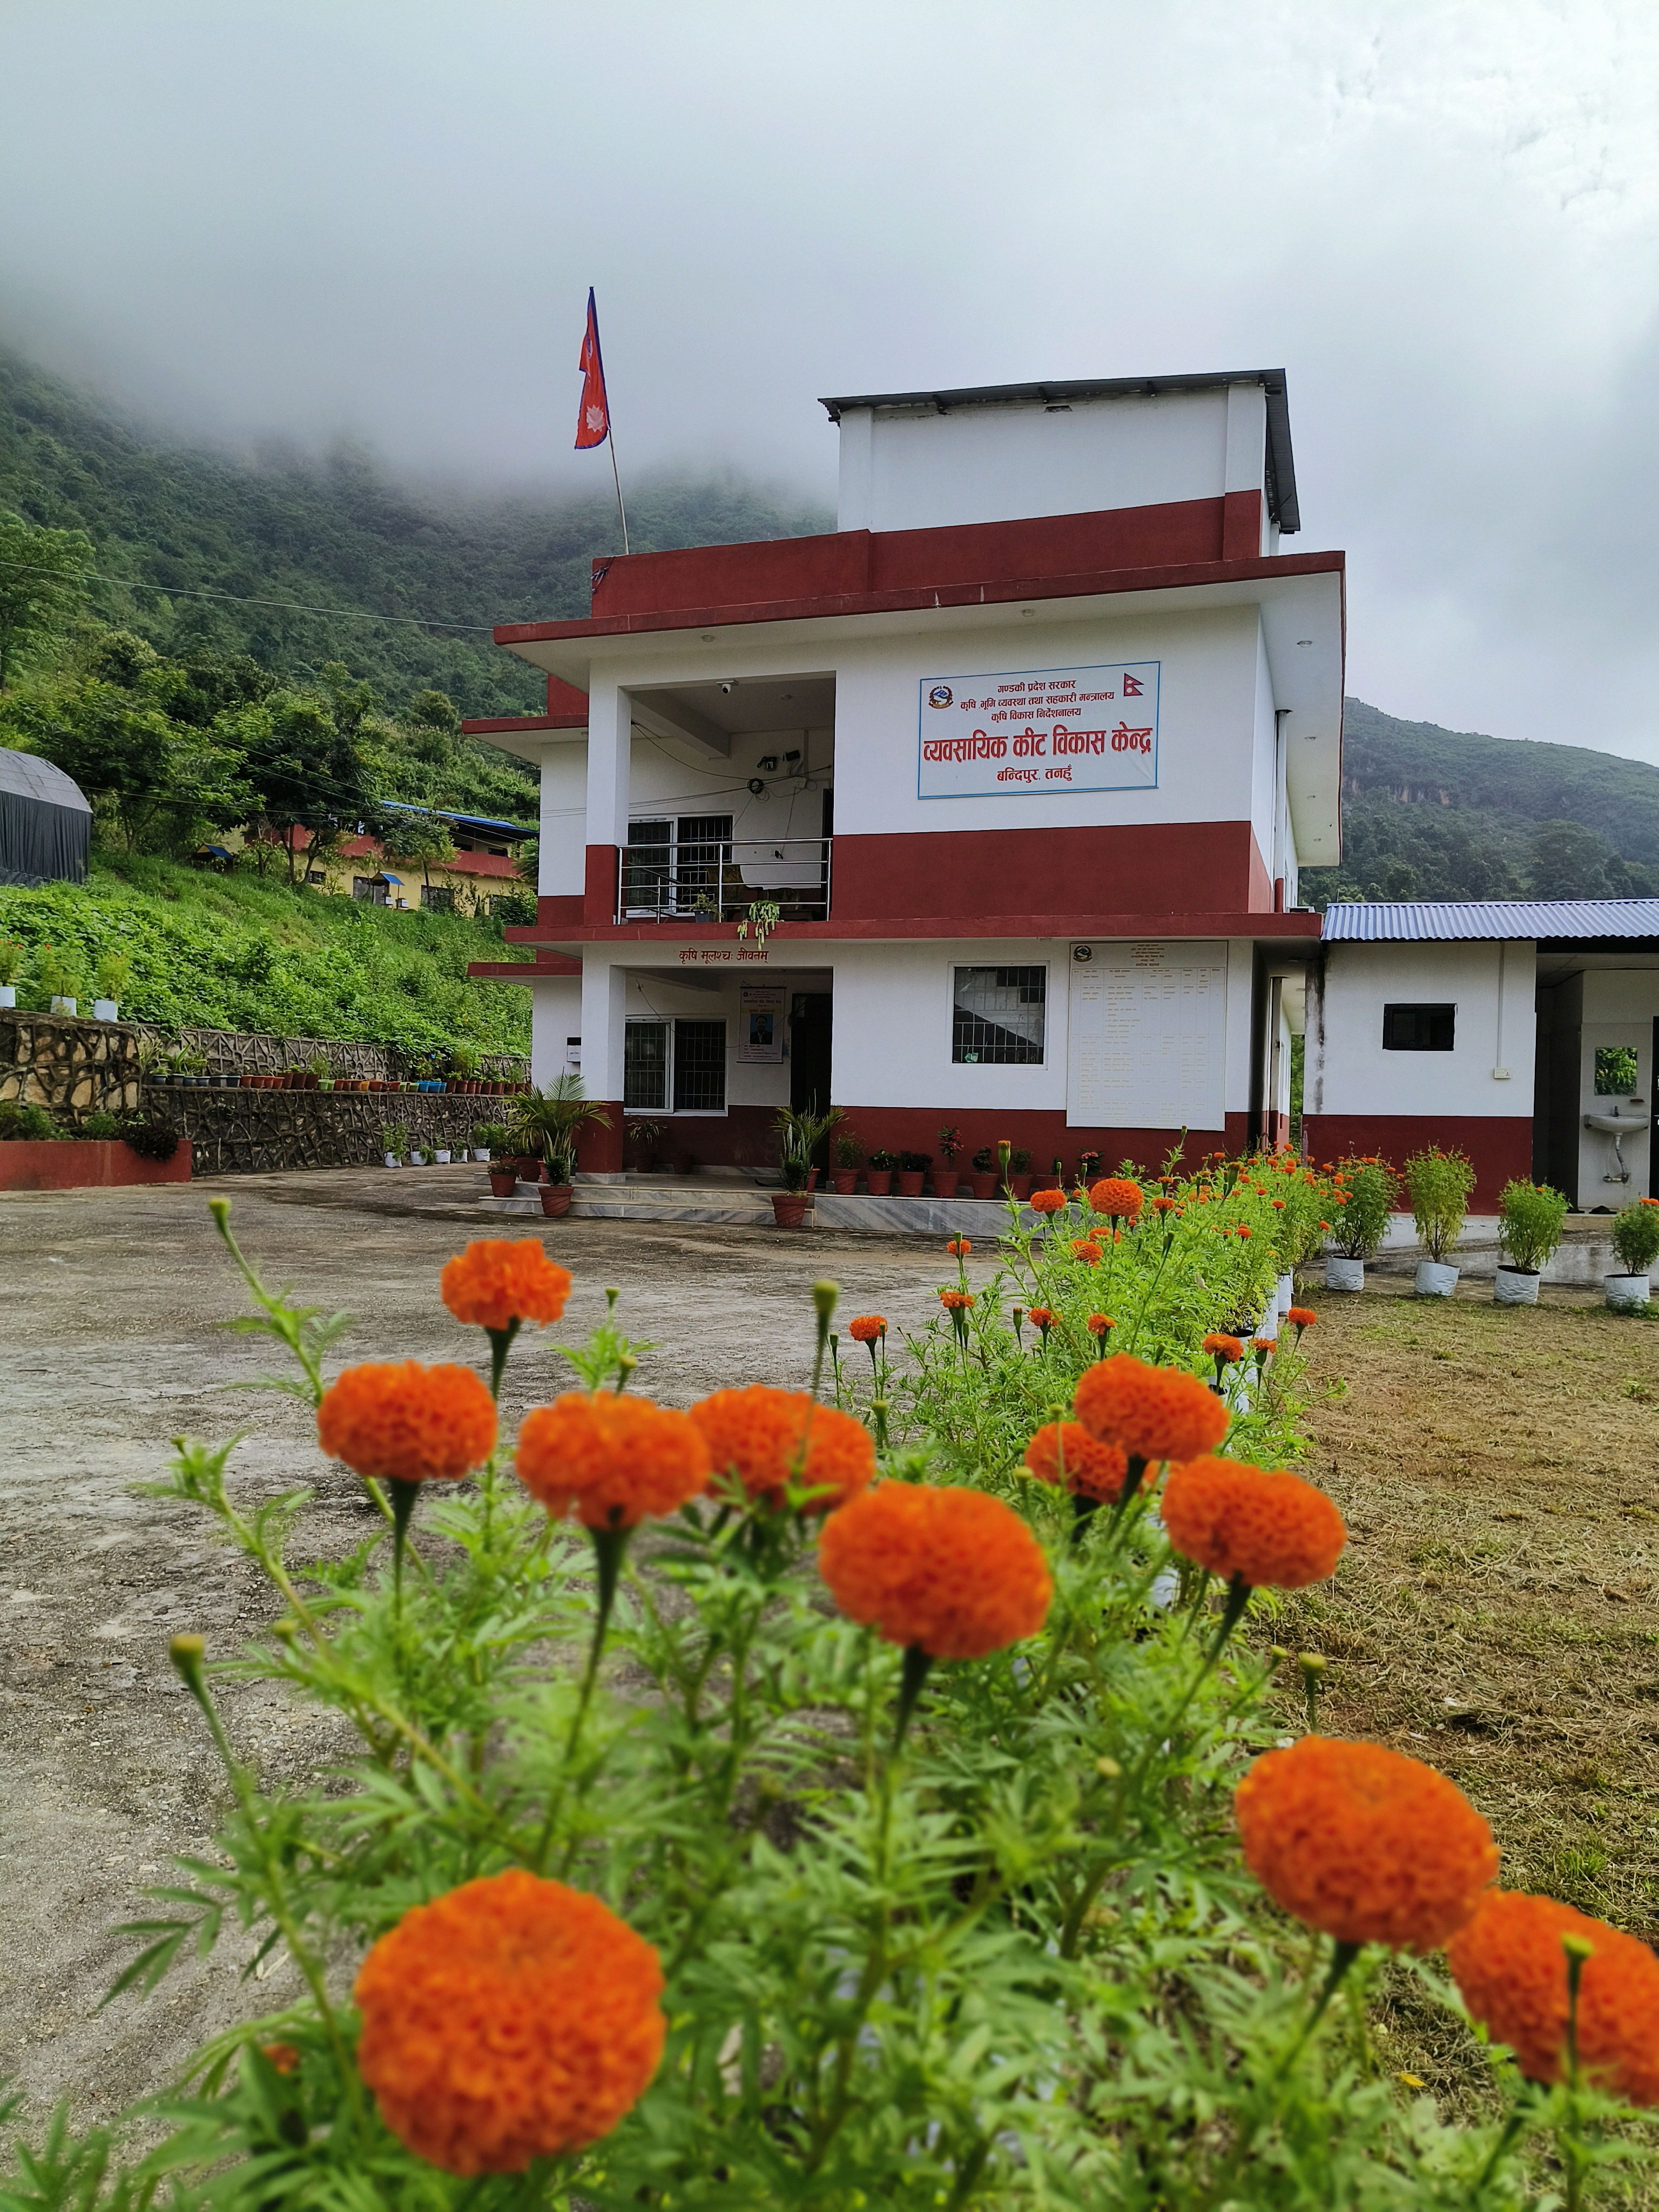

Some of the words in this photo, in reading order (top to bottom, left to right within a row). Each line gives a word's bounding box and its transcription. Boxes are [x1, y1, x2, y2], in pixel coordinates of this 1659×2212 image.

[997, 682, 1025, 693] गण्डकी
[1028, 681, 1046, 692] प्रदेश
[1048, 680, 1076, 690] सरकार
[960, 699, 976, 711] कृषि
[998, 697, 1026, 706] व्यवस्था
[1028, 696, 1043, 705] तथा
[1046, 692, 1076, 704] सहकारी
[1079, 692, 1115, 702] मन्त्रालय
[992, 711, 1007, 723] कृषि
[1010, 710, 1034, 719] विकास
[1036, 707, 1082, 718] निर्देशनालय
[923, 729, 1008, 762] व्यवसायिक
[1013, 727, 1048, 757] कीट
[1053, 724, 1107, 755] विकास
[1111, 721, 1153, 754] केन्द्र
[1045, 764, 1073, 781] तनहुँ
[679, 947, 698, 964] कृषि
[737, 947, 769, 963] जीवनम्
